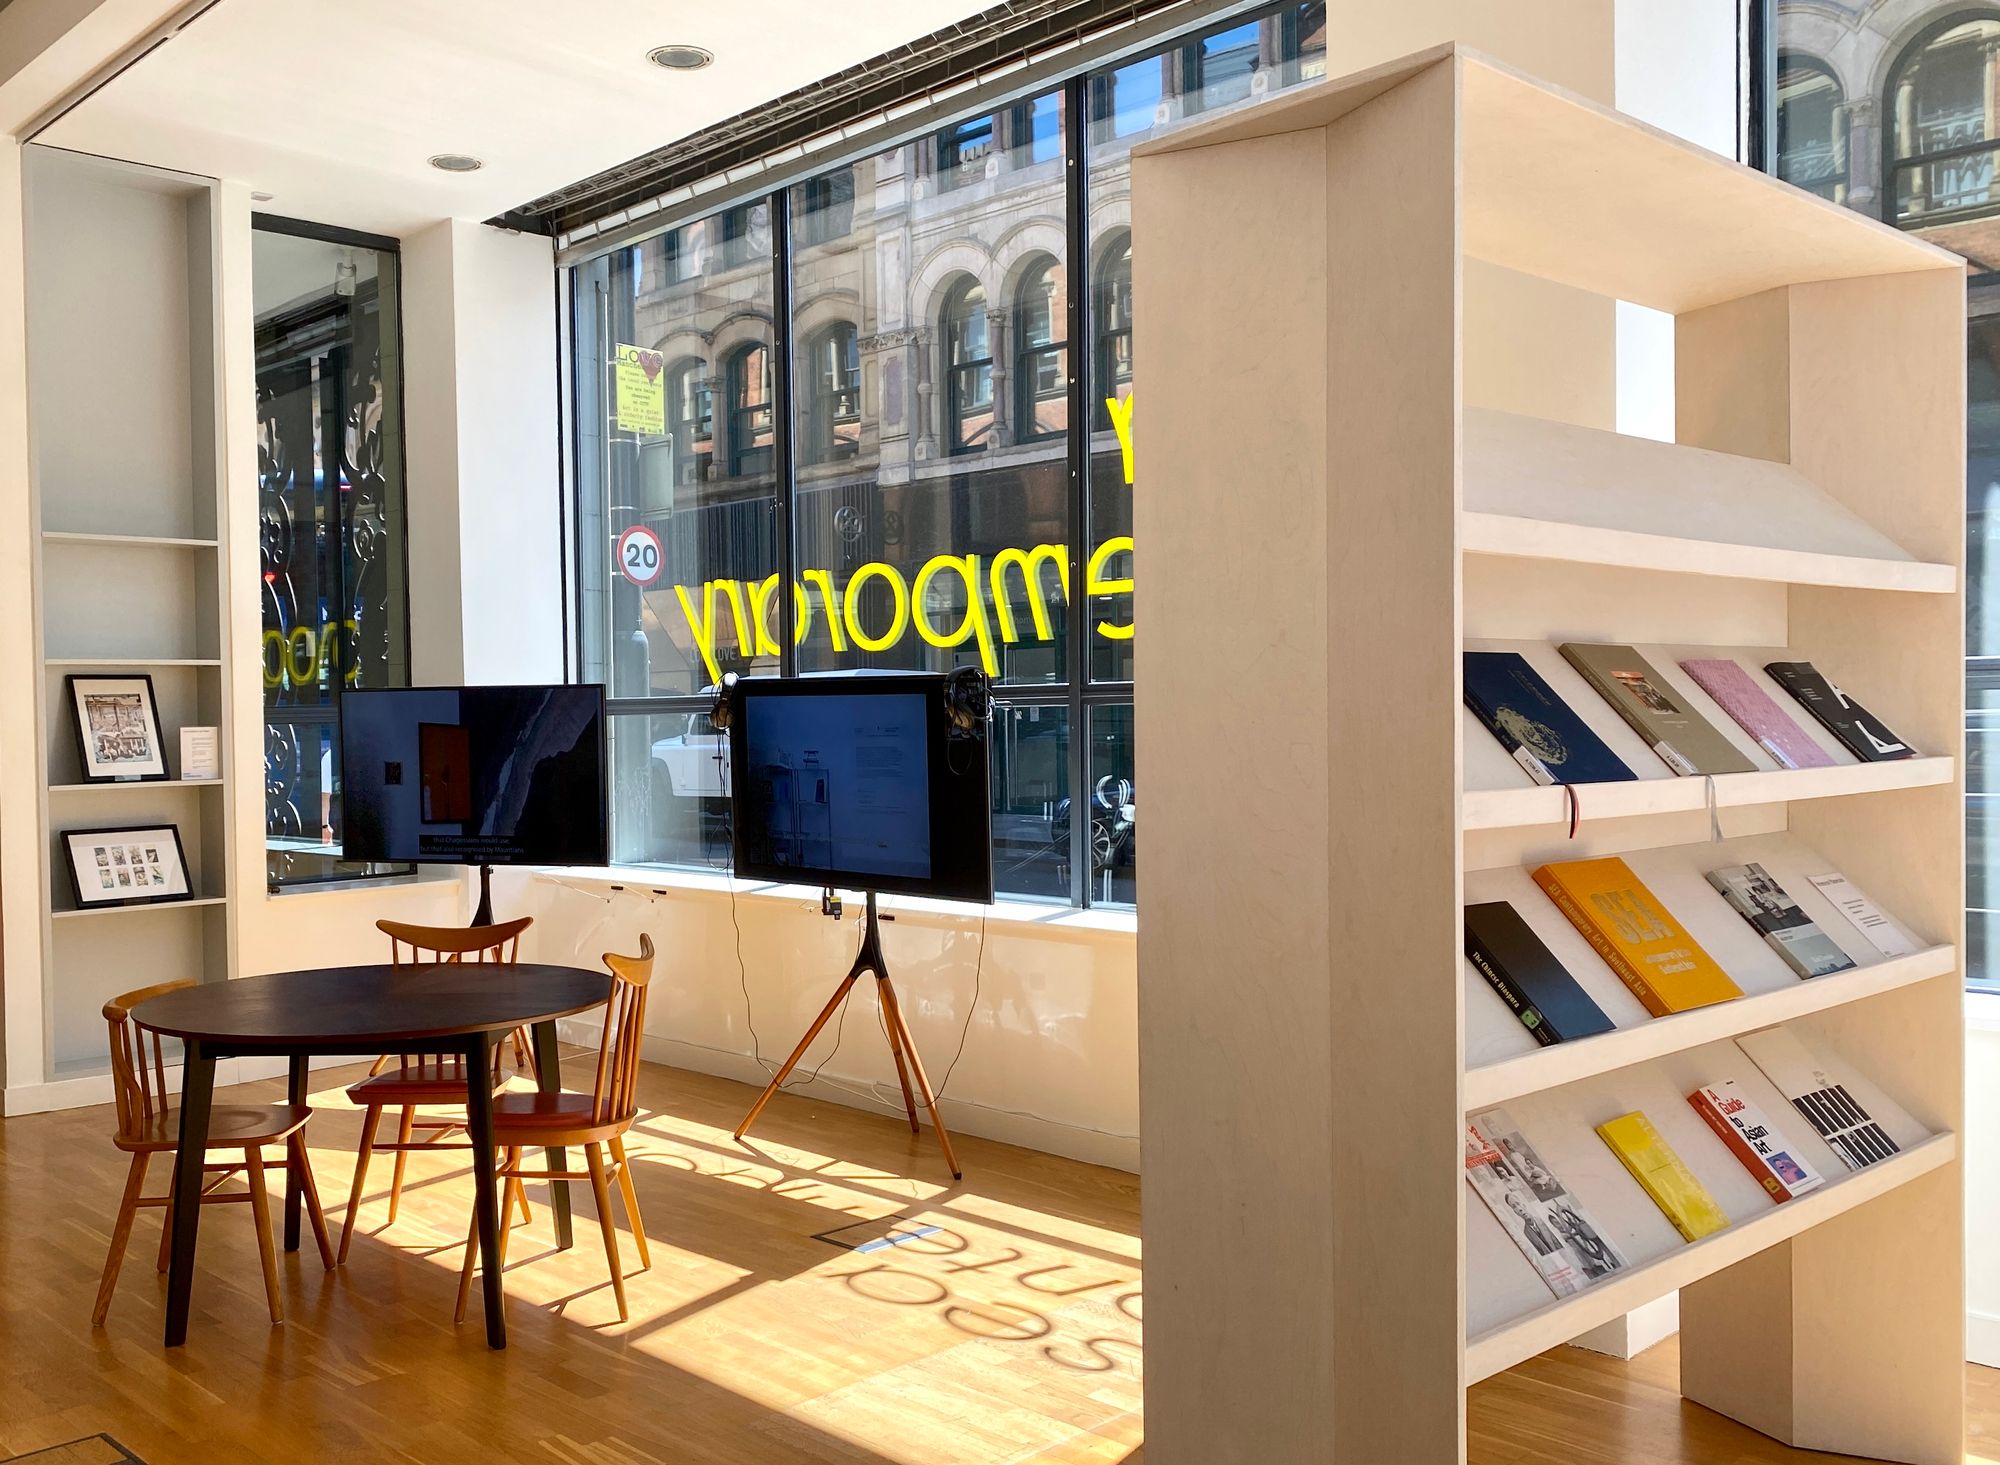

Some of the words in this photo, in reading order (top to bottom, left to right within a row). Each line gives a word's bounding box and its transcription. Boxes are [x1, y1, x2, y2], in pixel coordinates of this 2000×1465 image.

[627, 543, 658, 568] 20
[1472, 951, 1483, 965] The
[1481, 962, 1500, 985] Chinese
[1497, 981, 1520, 1009] Diaspora
[1707, 1089, 1720, 1103] A
[1718, 1097, 1746, 1115] Guide
[1729, 1116, 1745, 1129] to
[1741, 1125, 1770, 1142] Asian
[1753, 1140, 1773, 1156] Art
